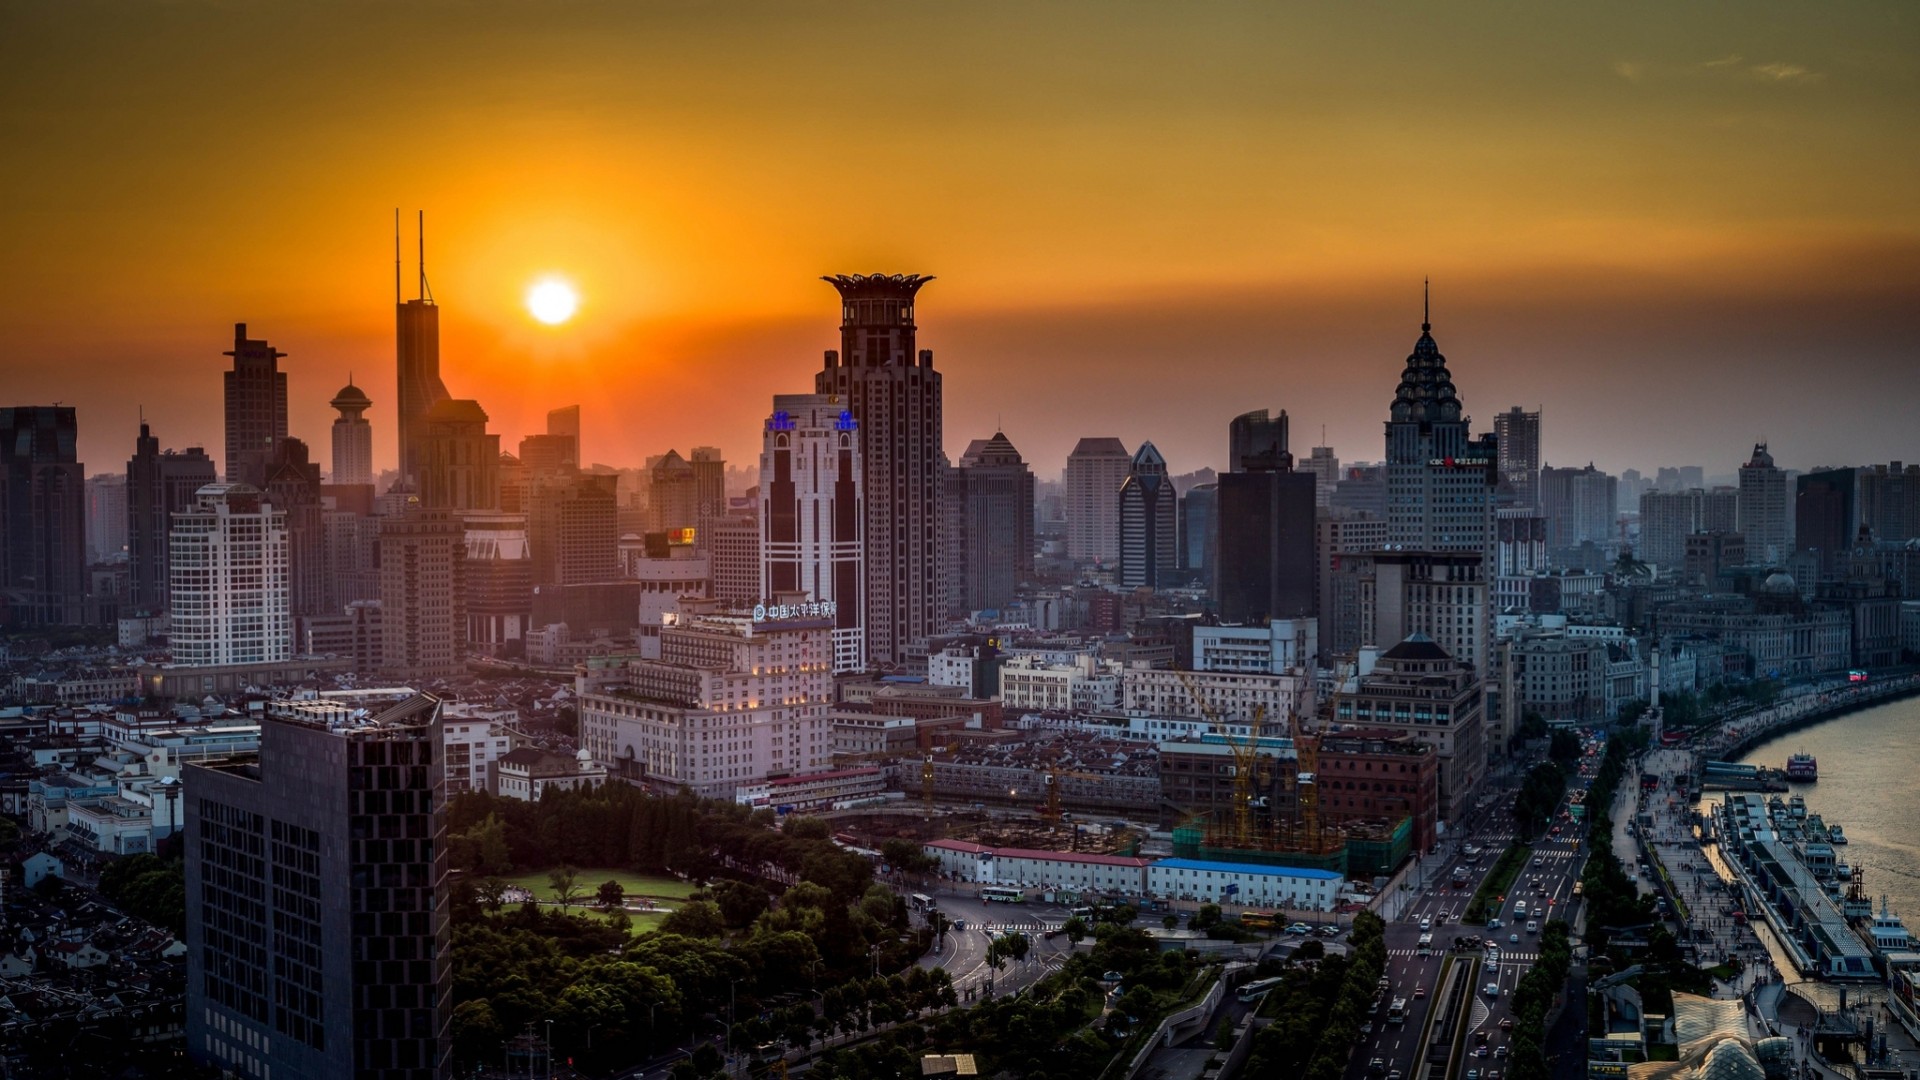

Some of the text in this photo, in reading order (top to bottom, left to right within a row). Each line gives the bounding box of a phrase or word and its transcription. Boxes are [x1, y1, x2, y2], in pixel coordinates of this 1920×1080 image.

[769, 602, 837, 618] 中国太平洋保险
